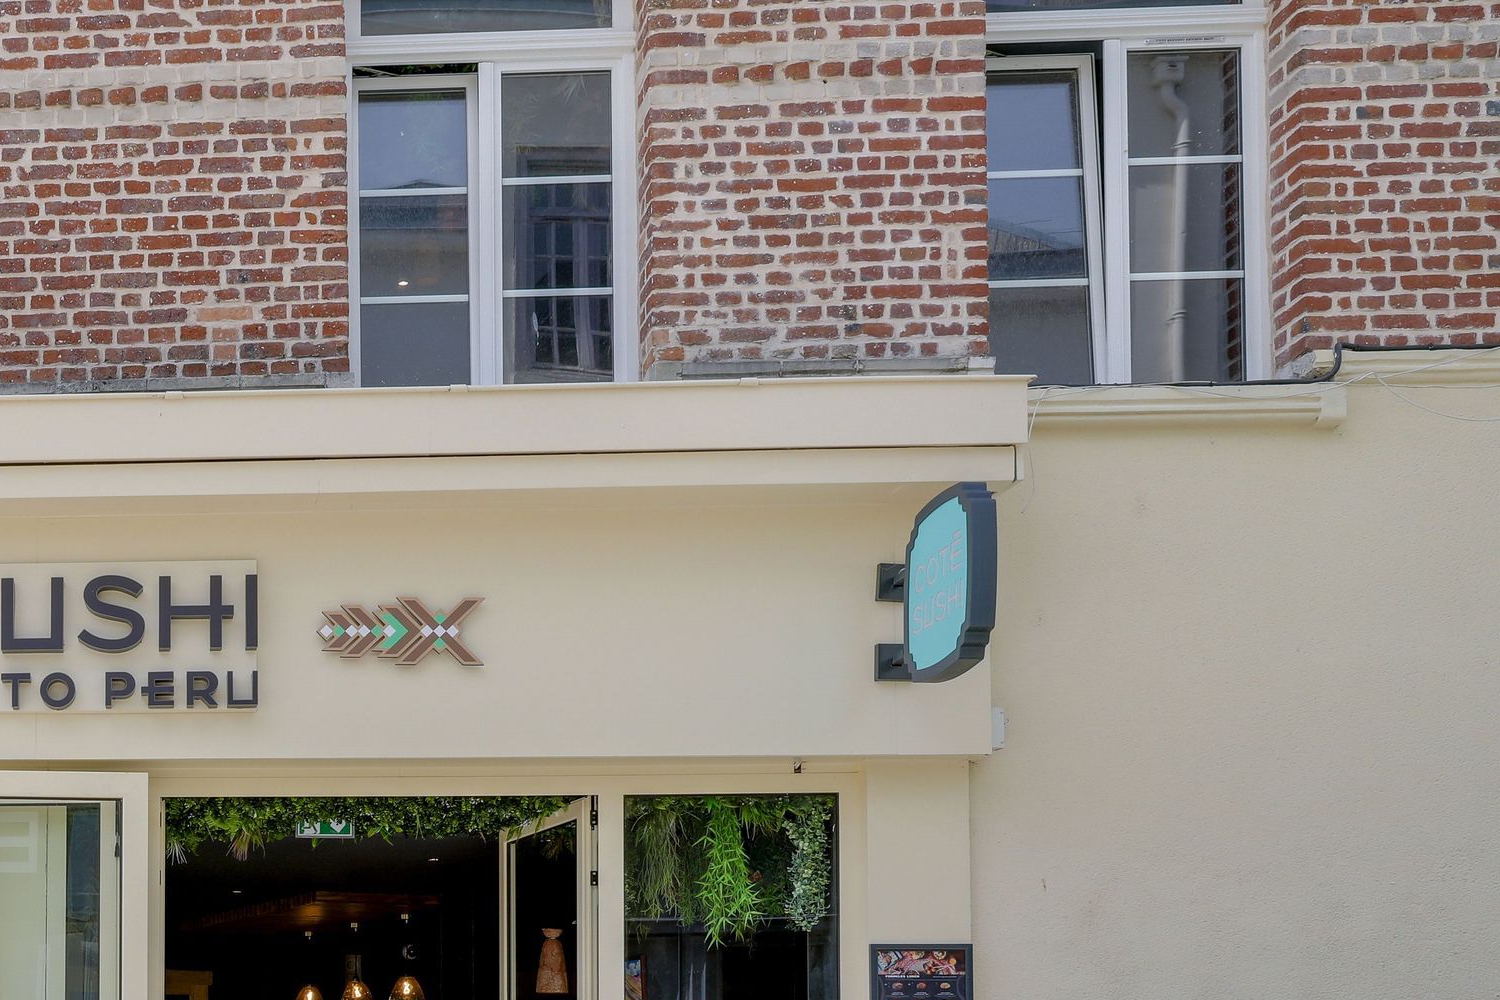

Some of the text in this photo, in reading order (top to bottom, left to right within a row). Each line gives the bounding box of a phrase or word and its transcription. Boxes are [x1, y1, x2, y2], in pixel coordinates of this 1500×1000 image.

[912, 578, 965, 636] SUSHI
[1, 671, 77, 710] TO
[104, 670, 258, 709] PERU
